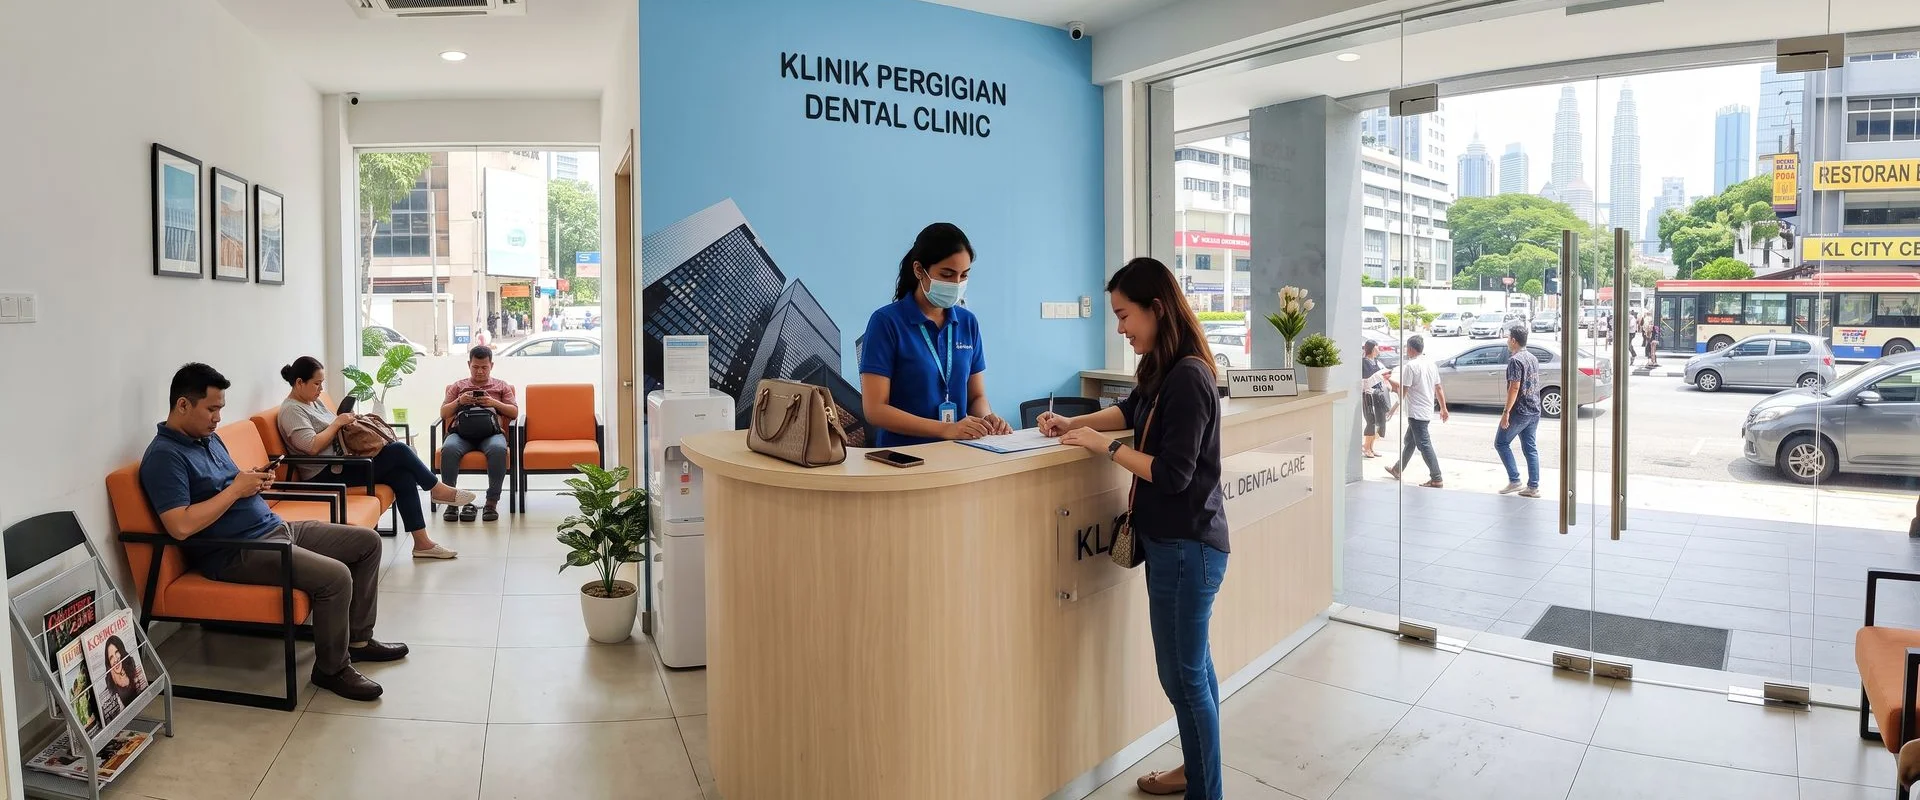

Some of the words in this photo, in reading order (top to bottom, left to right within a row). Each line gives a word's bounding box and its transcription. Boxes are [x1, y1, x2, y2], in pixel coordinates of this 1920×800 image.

[781, 52, 870, 88] KLINIK
[877, 64, 1007, 106] PERGIGIAN
[805, 94, 907, 129] DENTAL
[913, 106, 991, 138] CLINIC
[1819, 163, 1910, 184] RESTORAN
[1821, 241, 1845, 257] KL
[1850, 241, 1894, 257] CITY
[1268, 374, 1293, 382] ROOM
[1238, 466, 1279, 496] DENTAL
[1280, 455, 1305, 478] CARE
[1077, 523, 1109, 560] KL
